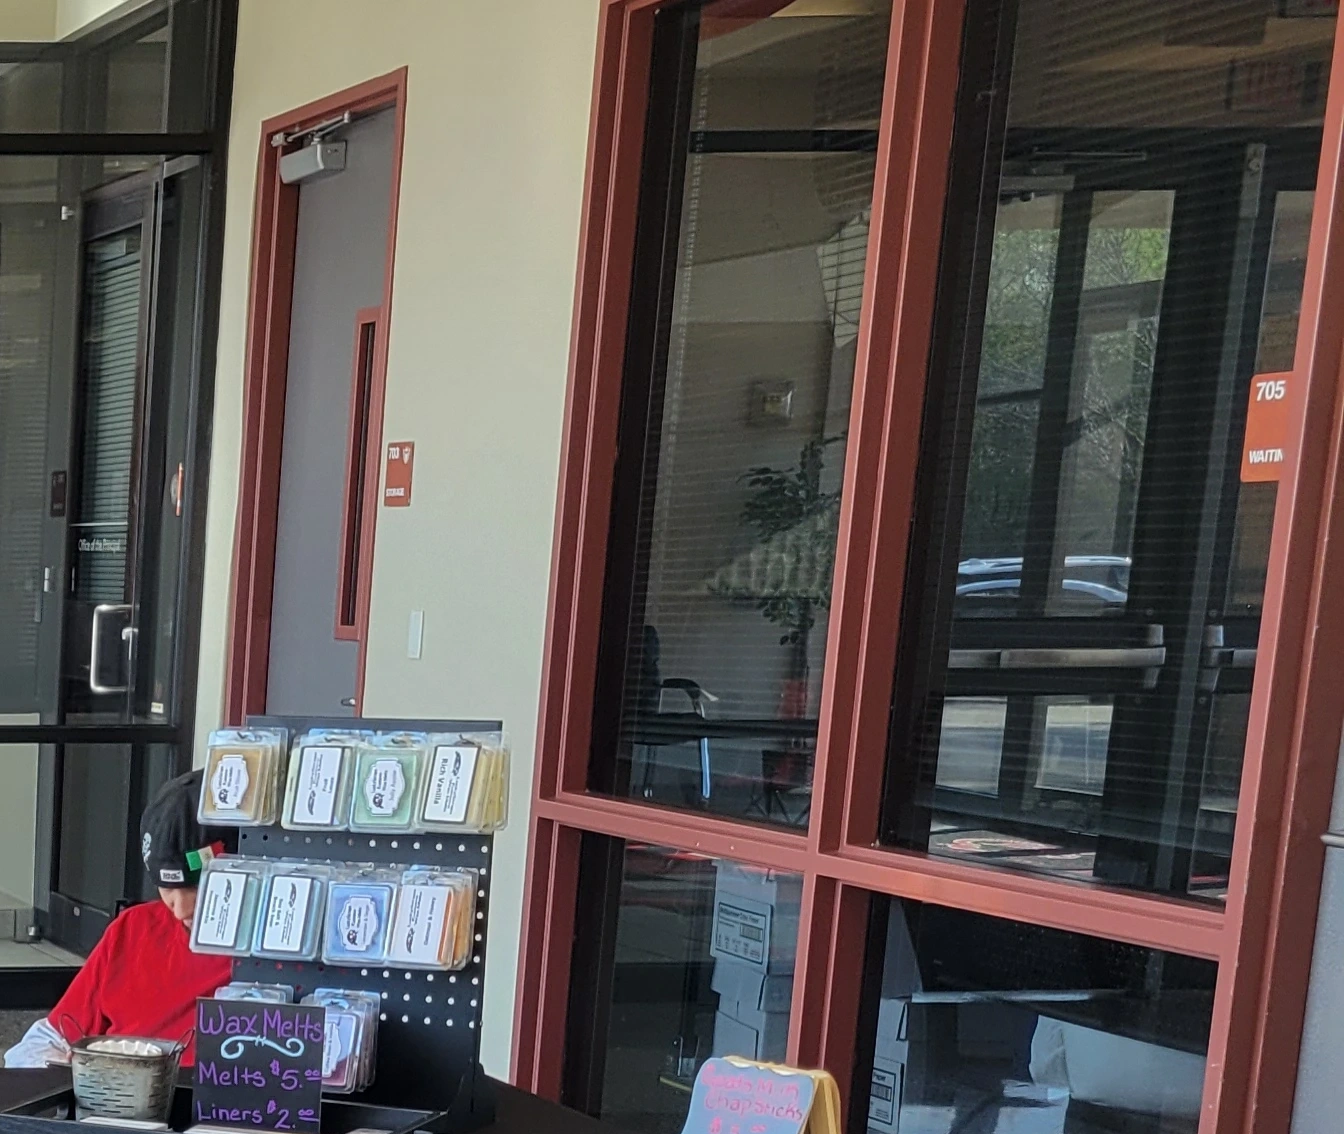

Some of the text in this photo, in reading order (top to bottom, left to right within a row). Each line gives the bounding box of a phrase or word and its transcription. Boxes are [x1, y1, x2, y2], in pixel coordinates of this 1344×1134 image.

[1256, 380, 1286, 402] 705
[1249, 448, 1283, 464] WAITIN
[433, 757, 449, 805] Rich Vanilla
[198, 1003, 323, 1042] Wax Melts
[198, 1061, 266, 1088] Melts
[197, 1100, 262, 1123] Liners
